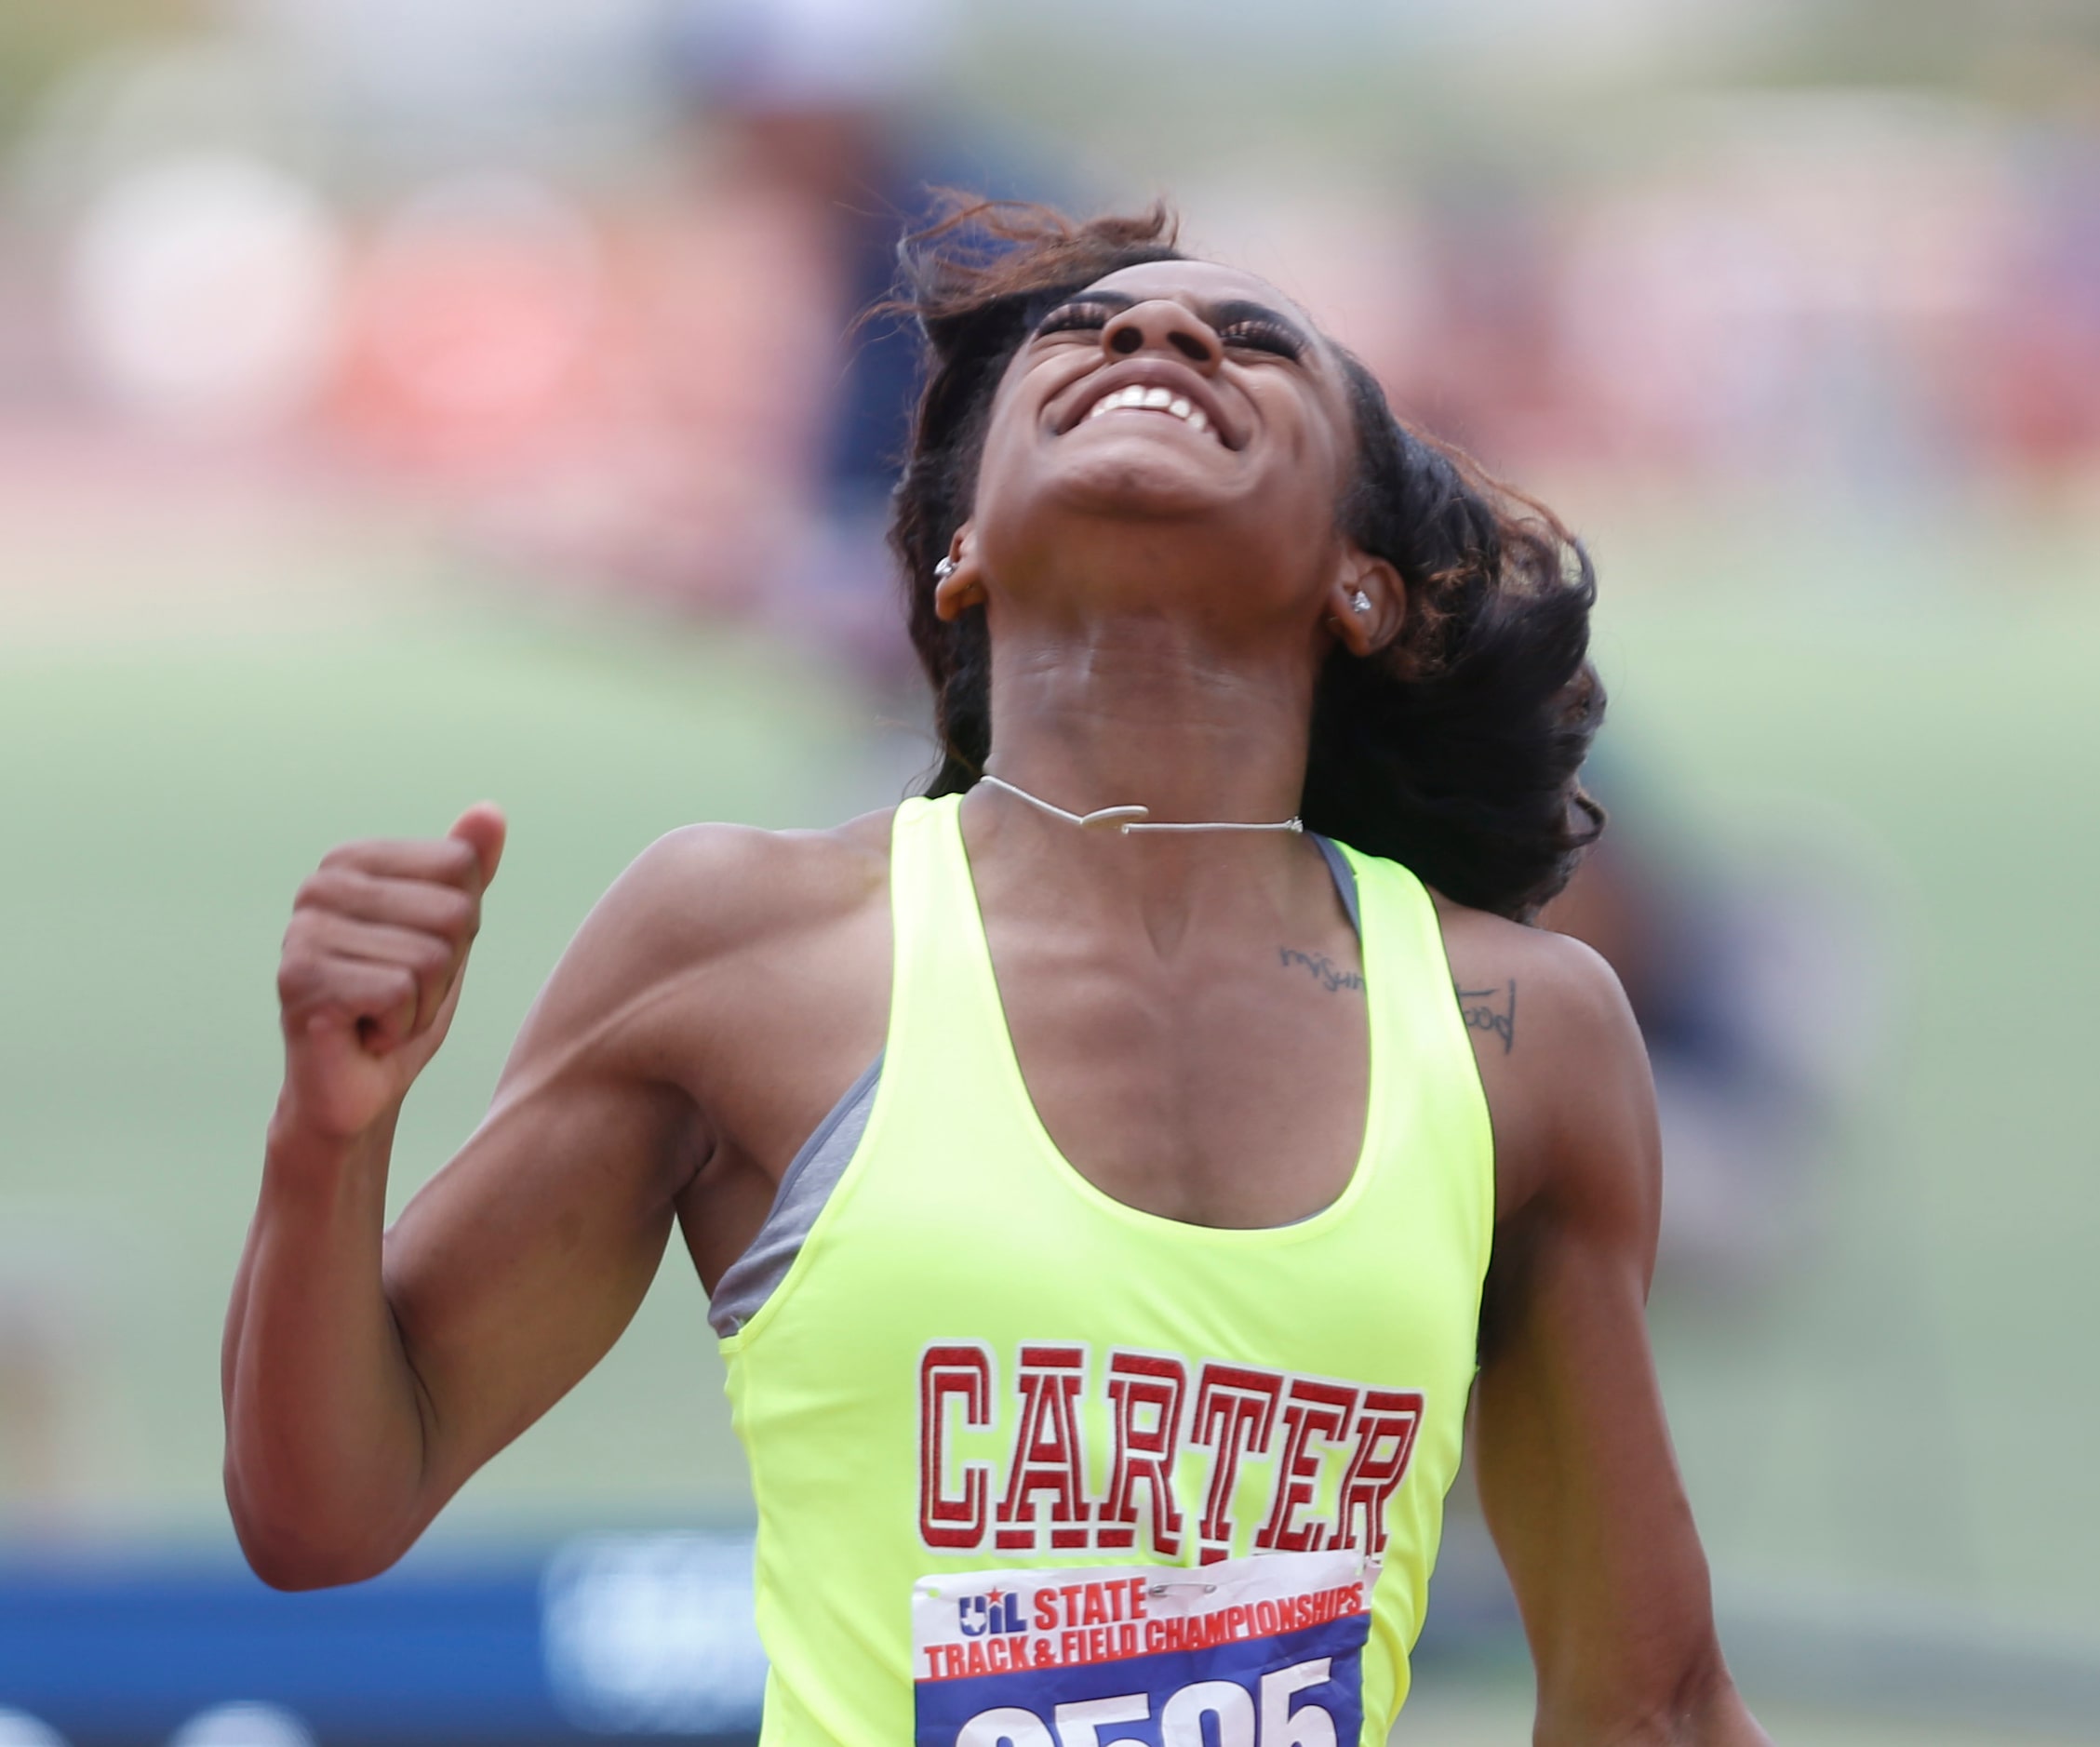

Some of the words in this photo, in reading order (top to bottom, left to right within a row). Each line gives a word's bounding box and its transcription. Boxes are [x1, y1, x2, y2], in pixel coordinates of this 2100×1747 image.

[919, 1341, 1425, 1568] CARTER
[924, 1635, 1028, 1678] TRACK
[1060, 1621, 1138, 1664] FIELD
[1145, 1581, 1364, 1653] CHAMPIONSHIPS
[1034, 1577, 1147, 1630] STATE
